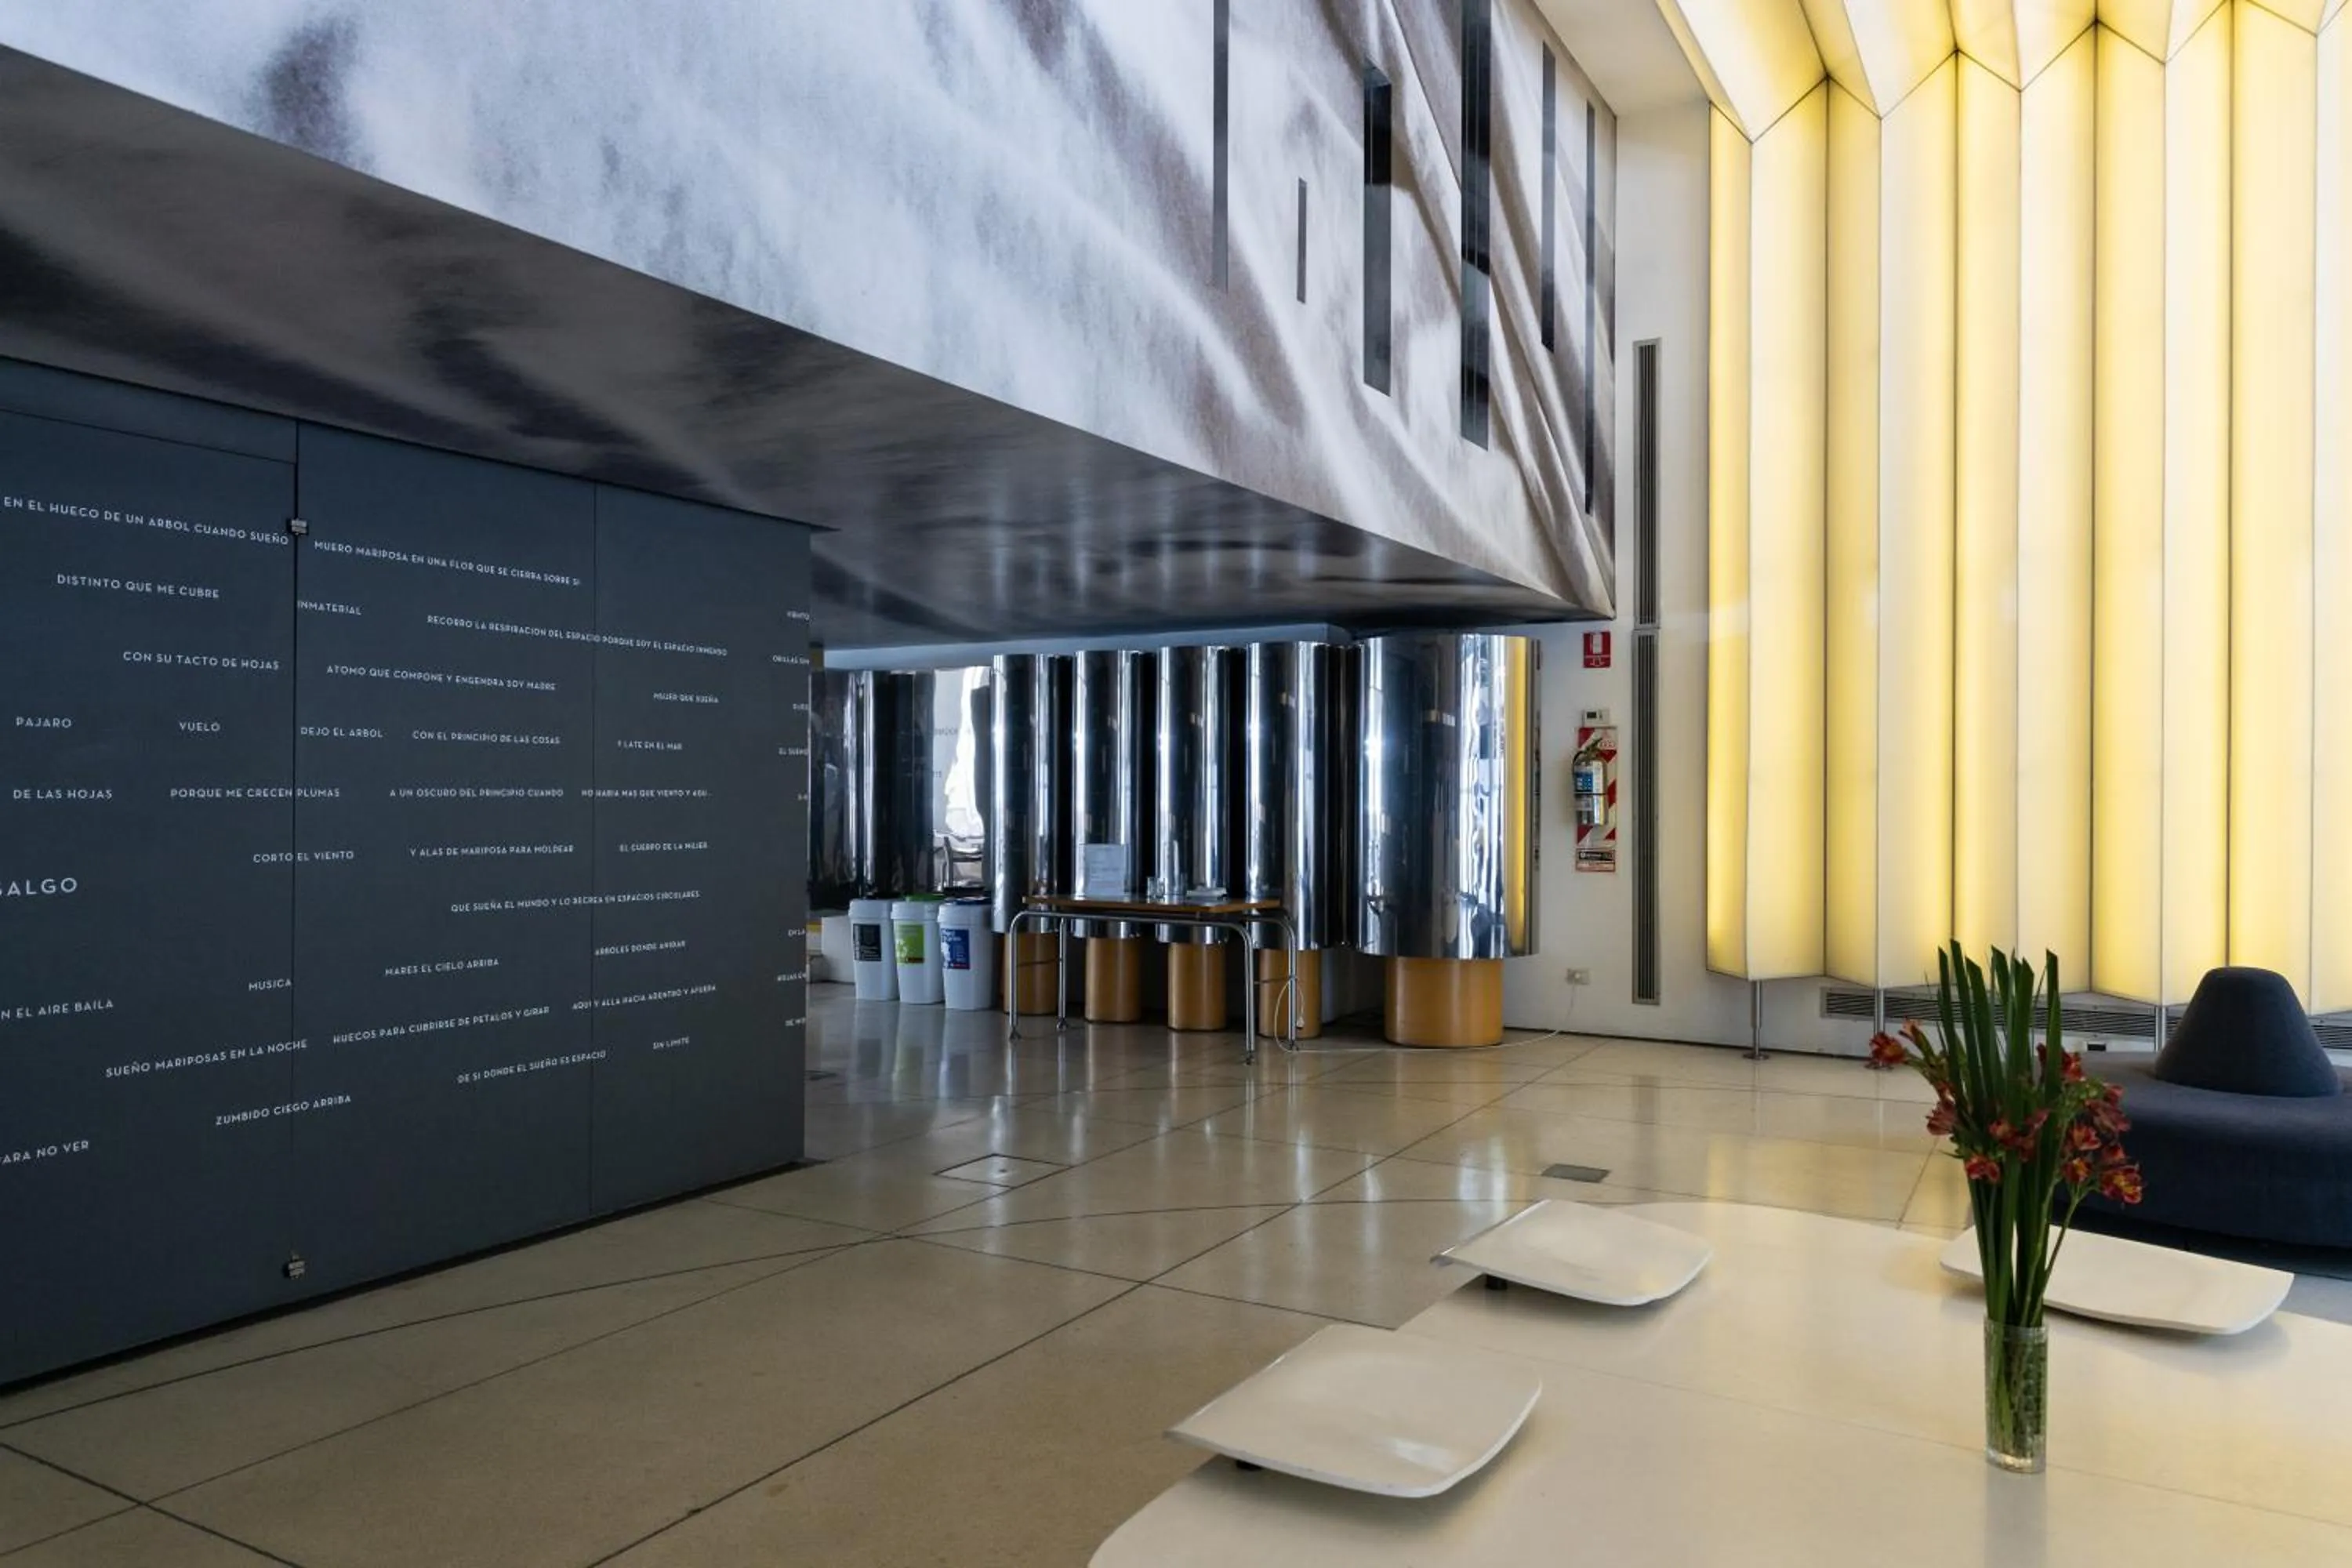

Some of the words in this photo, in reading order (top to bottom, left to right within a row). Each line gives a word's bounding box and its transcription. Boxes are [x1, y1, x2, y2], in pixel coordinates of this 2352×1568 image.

[4, 496, 23, 508] EN
[27, 499, 45, 512] EL
[49, 503, 100, 518] HUECO
[103, 510, 121, 522] DE
[125, 514, 143, 524] UN
[148, 517, 190, 532] ARBOL
[194, 524, 247, 539] CUANDO
[250, 532, 289, 545] SUEÑO
[314, 539, 353, 554] MUERO
[355, 546, 408, 562] MARIPOSA
[411, 554, 424, 564] EN
[426, 556, 447, 567] UNA
[449, 559, 474, 572] FLOR
[476, 564, 495, 574] QUE
[498, 567, 508, 576] SE
[510, 568, 542, 581] CIERRA
[543, 573, 571, 585] SOBRE
[57, 573, 122, 590] DISTINTO
[125, 581, 152, 593] QUE
[157, 584, 175, 595] ME
[179, 586, 219, 599] CUBRE
[297, 600, 361, 615] INMATERIAL
[427, 615, 473, 628] RECORRO
[475, 621, 487, 630] LA
[488, 622, 546, 636] RESPIRACION
[548, 629, 564, 639] DEL
[123, 651, 152, 662] CON
[156, 653, 172, 663] SU
[176, 655, 218, 666] TACTO
[222, 658, 237, 667] DE
[241, 659, 279, 670] HOJAS
[326, 665, 366, 676] ATOMO
[368, 668, 390, 678] QUE
[393, 670, 444, 683] COMPONE
[456, 675, 504, 687] ENGENDRA
[526, 681, 556, 691] MADRE
[16, 716, 72, 728] PAJARO
[179, 721, 220, 732] VUELO
[300, 727, 330, 736] DEJO
[333, 728, 345, 736] EL
[349, 728, 383, 738] ARBOL
[412, 730, 434, 739] CON
[437, 731, 448, 741] EL
[451, 732, 497, 742] PRINCIPIO
[499, 734, 512, 742] DE
[514, 735, 529, 744] LAS
[532, 735, 561, 744] COSAS
[13, 789, 31, 800] DE
[37, 789, 62, 799] LAS
[67, 789, 112, 800] HOJAS
[170, 788, 222, 800] PORQUE
[226, 788, 242, 797] ME
[247, 788, 292, 797] CRECEN
[296, 788, 339, 797] PLUMAS
[399, 789, 413, 797] UN
[416, 788, 457, 797] OSCURO
[459, 788, 477, 797] DEL
[479, 788, 525, 797] PRINCIPIO
[527, 789, 564, 797] CUANDO
[253, 853, 293, 863] CORTO
[297, 853, 310, 862] EL
[314, 851, 354, 860] VIENTO
[410, 848, 416, 857] Y
[419, 848, 443, 857] ALAS
[446, 848, 459, 856] DE
[460, 846, 507, 855] MARIPOSA
[534, 844, 574, 854] MOLDEAR
[0, 877, 78, 896] ALGO
[451, 903, 470, 913] QUE
[504, 901, 514, 909] EL
[517, 898, 550, 909] MUNDO
[559, 898, 571, 906] LO
[385, 966, 418, 976] MARES
[421, 964, 432, 973] EL
[435, 960, 464, 972] CIELO
[466, 958, 499, 968] ARRIBA
[249, 978, 292, 991] MUSICA
[16, 1007, 33, 1018] EL
[38, 1003, 69, 1016] AIRE
[74, 999, 114, 1012] BAILA
[333, 1029, 377, 1044] HUECOS
[379, 1026, 405, 1038] PARA
[408, 1018, 456, 1033] CUBRIRSE
[458, 1017, 470, 1026] DE
[473, 1011, 513, 1024] PETALOS
[524, 1006, 550, 1017] GIRAR
[106, 1061, 151, 1078] SUEÑO
[155, 1051, 227, 1070] MARIPOSAS
[230, 1047, 245, 1059] EN
[249, 1046, 264, 1056] LA
[267, 1039, 307, 1054] NOCHE
[456, 1073, 470, 1083] DE
[472, 1073, 481, 1081] SI
[483, 1066, 515, 1079] DONDE
[517, 1064, 528, 1073] EL
[560, 1056, 570, 1065] ES
[216, 1108, 270, 1126] ZUMBIDO
[274, 1101, 310, 1116] CIEGO
[313, 1095, 351, 1109] ARRIBA
[0, 1151, 31, 1165] ARA
[37, 1145, 57, 1158] NO
[63, 1140, 89, 1153] VER
